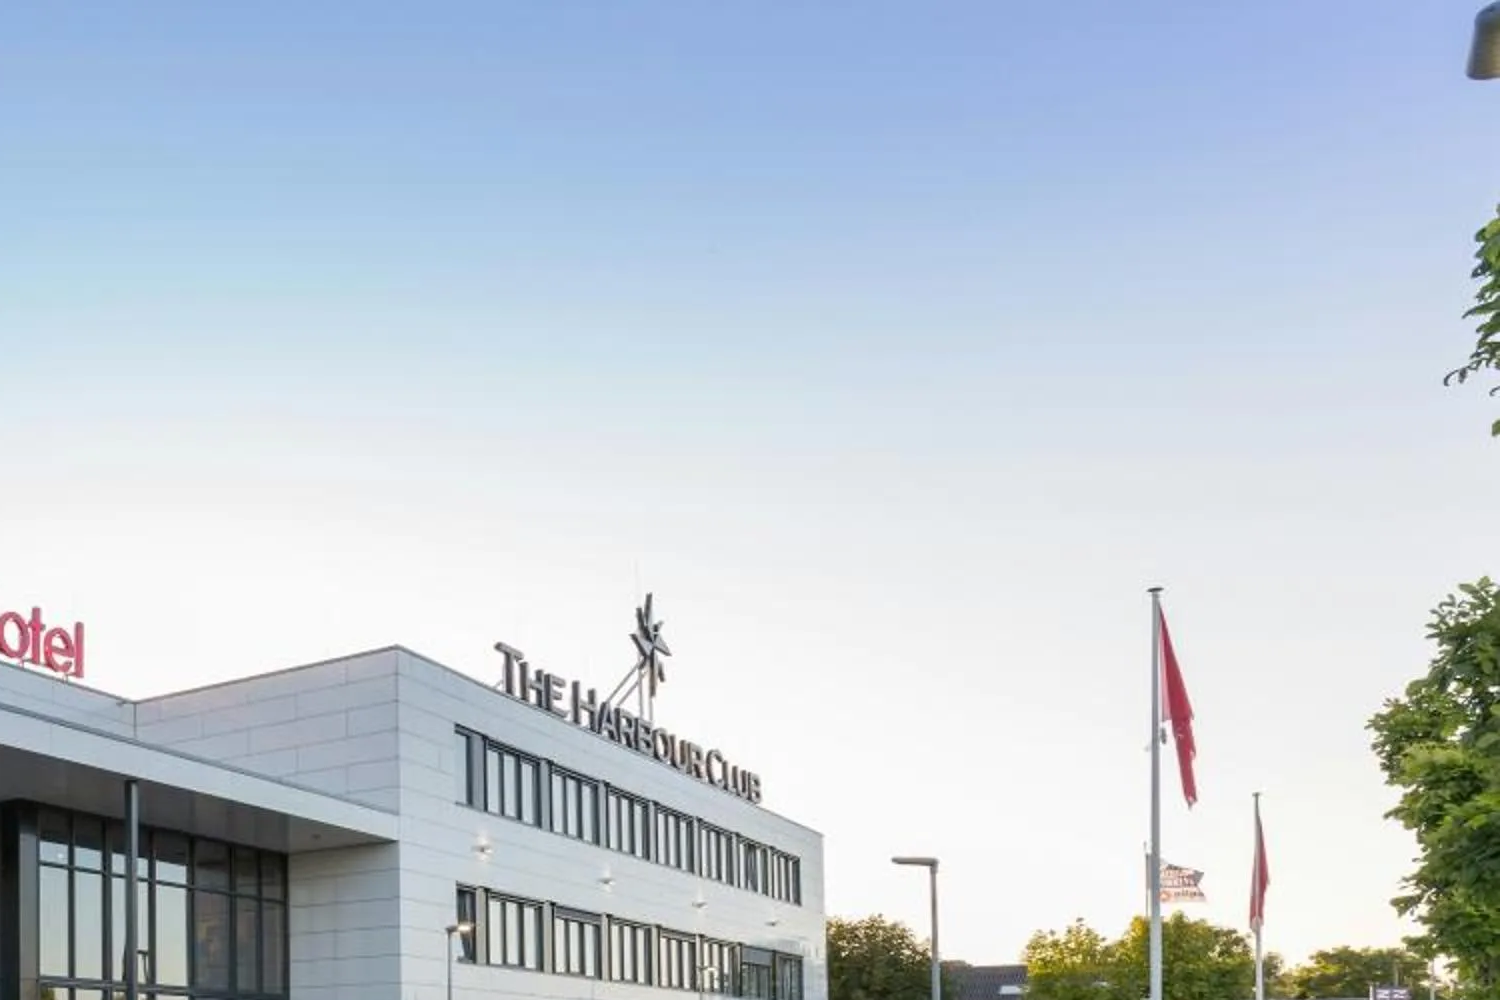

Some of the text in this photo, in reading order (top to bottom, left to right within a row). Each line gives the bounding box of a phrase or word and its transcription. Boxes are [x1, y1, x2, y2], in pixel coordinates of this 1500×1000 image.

[494, 641, 762, 803] THE HARBOUR CLUB
